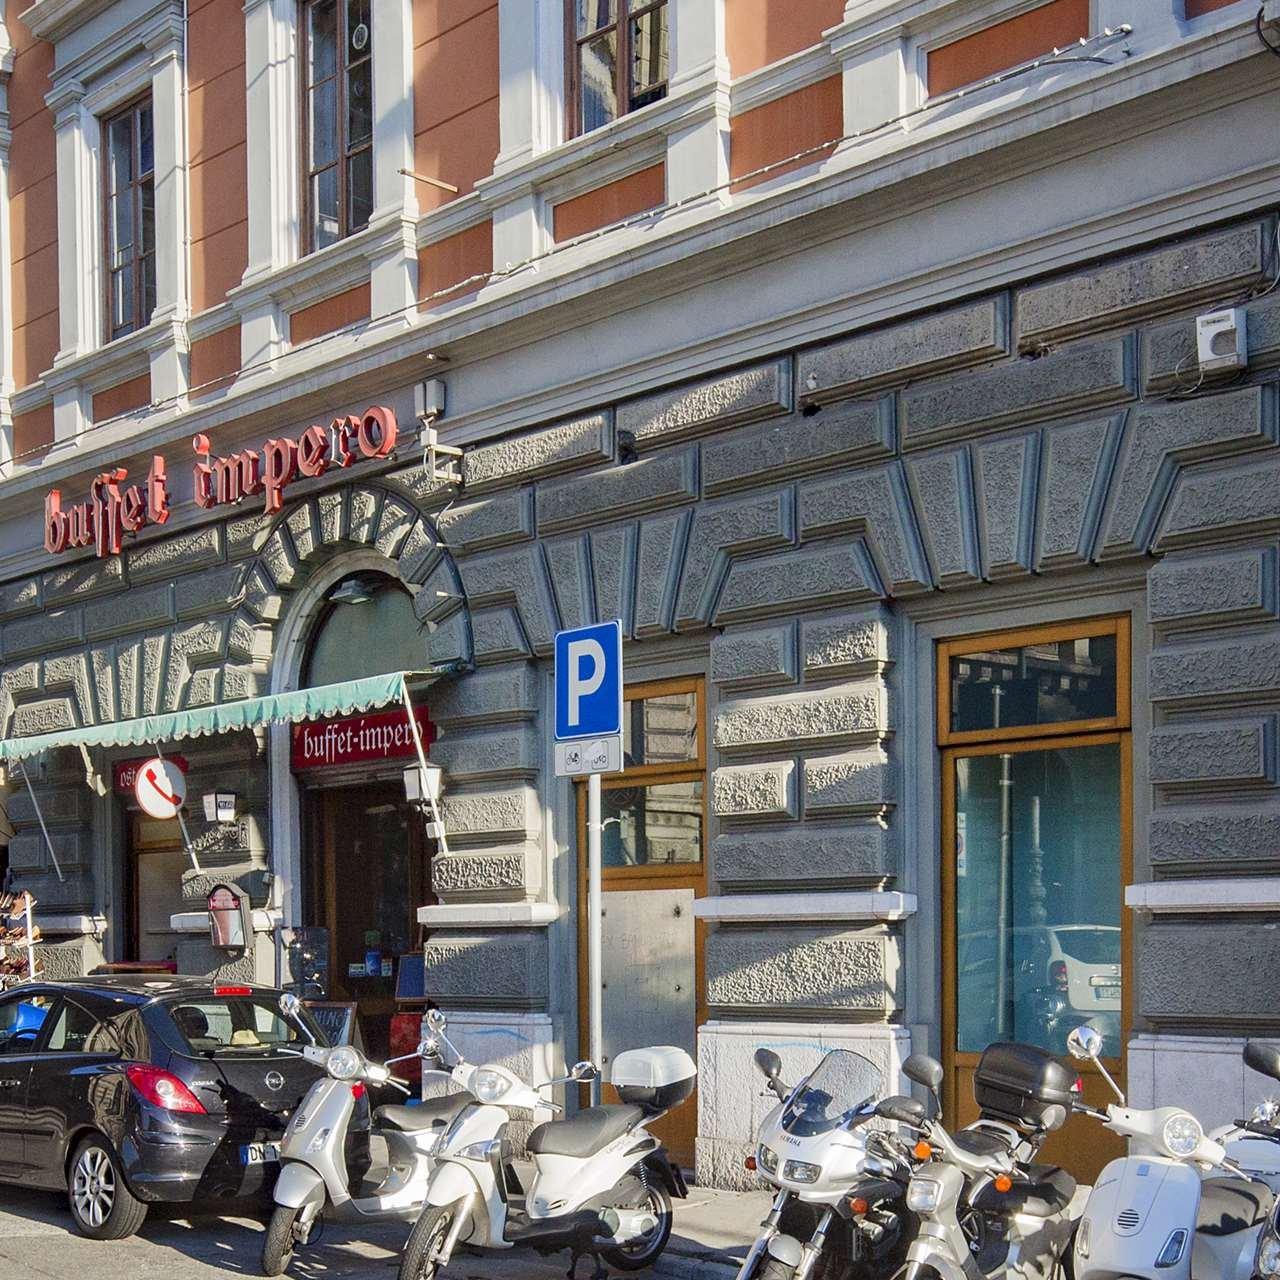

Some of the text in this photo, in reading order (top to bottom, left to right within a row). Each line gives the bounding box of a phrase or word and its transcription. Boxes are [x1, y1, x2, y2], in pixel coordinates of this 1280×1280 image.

[44, 405, 400, 558] buffet impero
[568, 639, 606, 726] P
